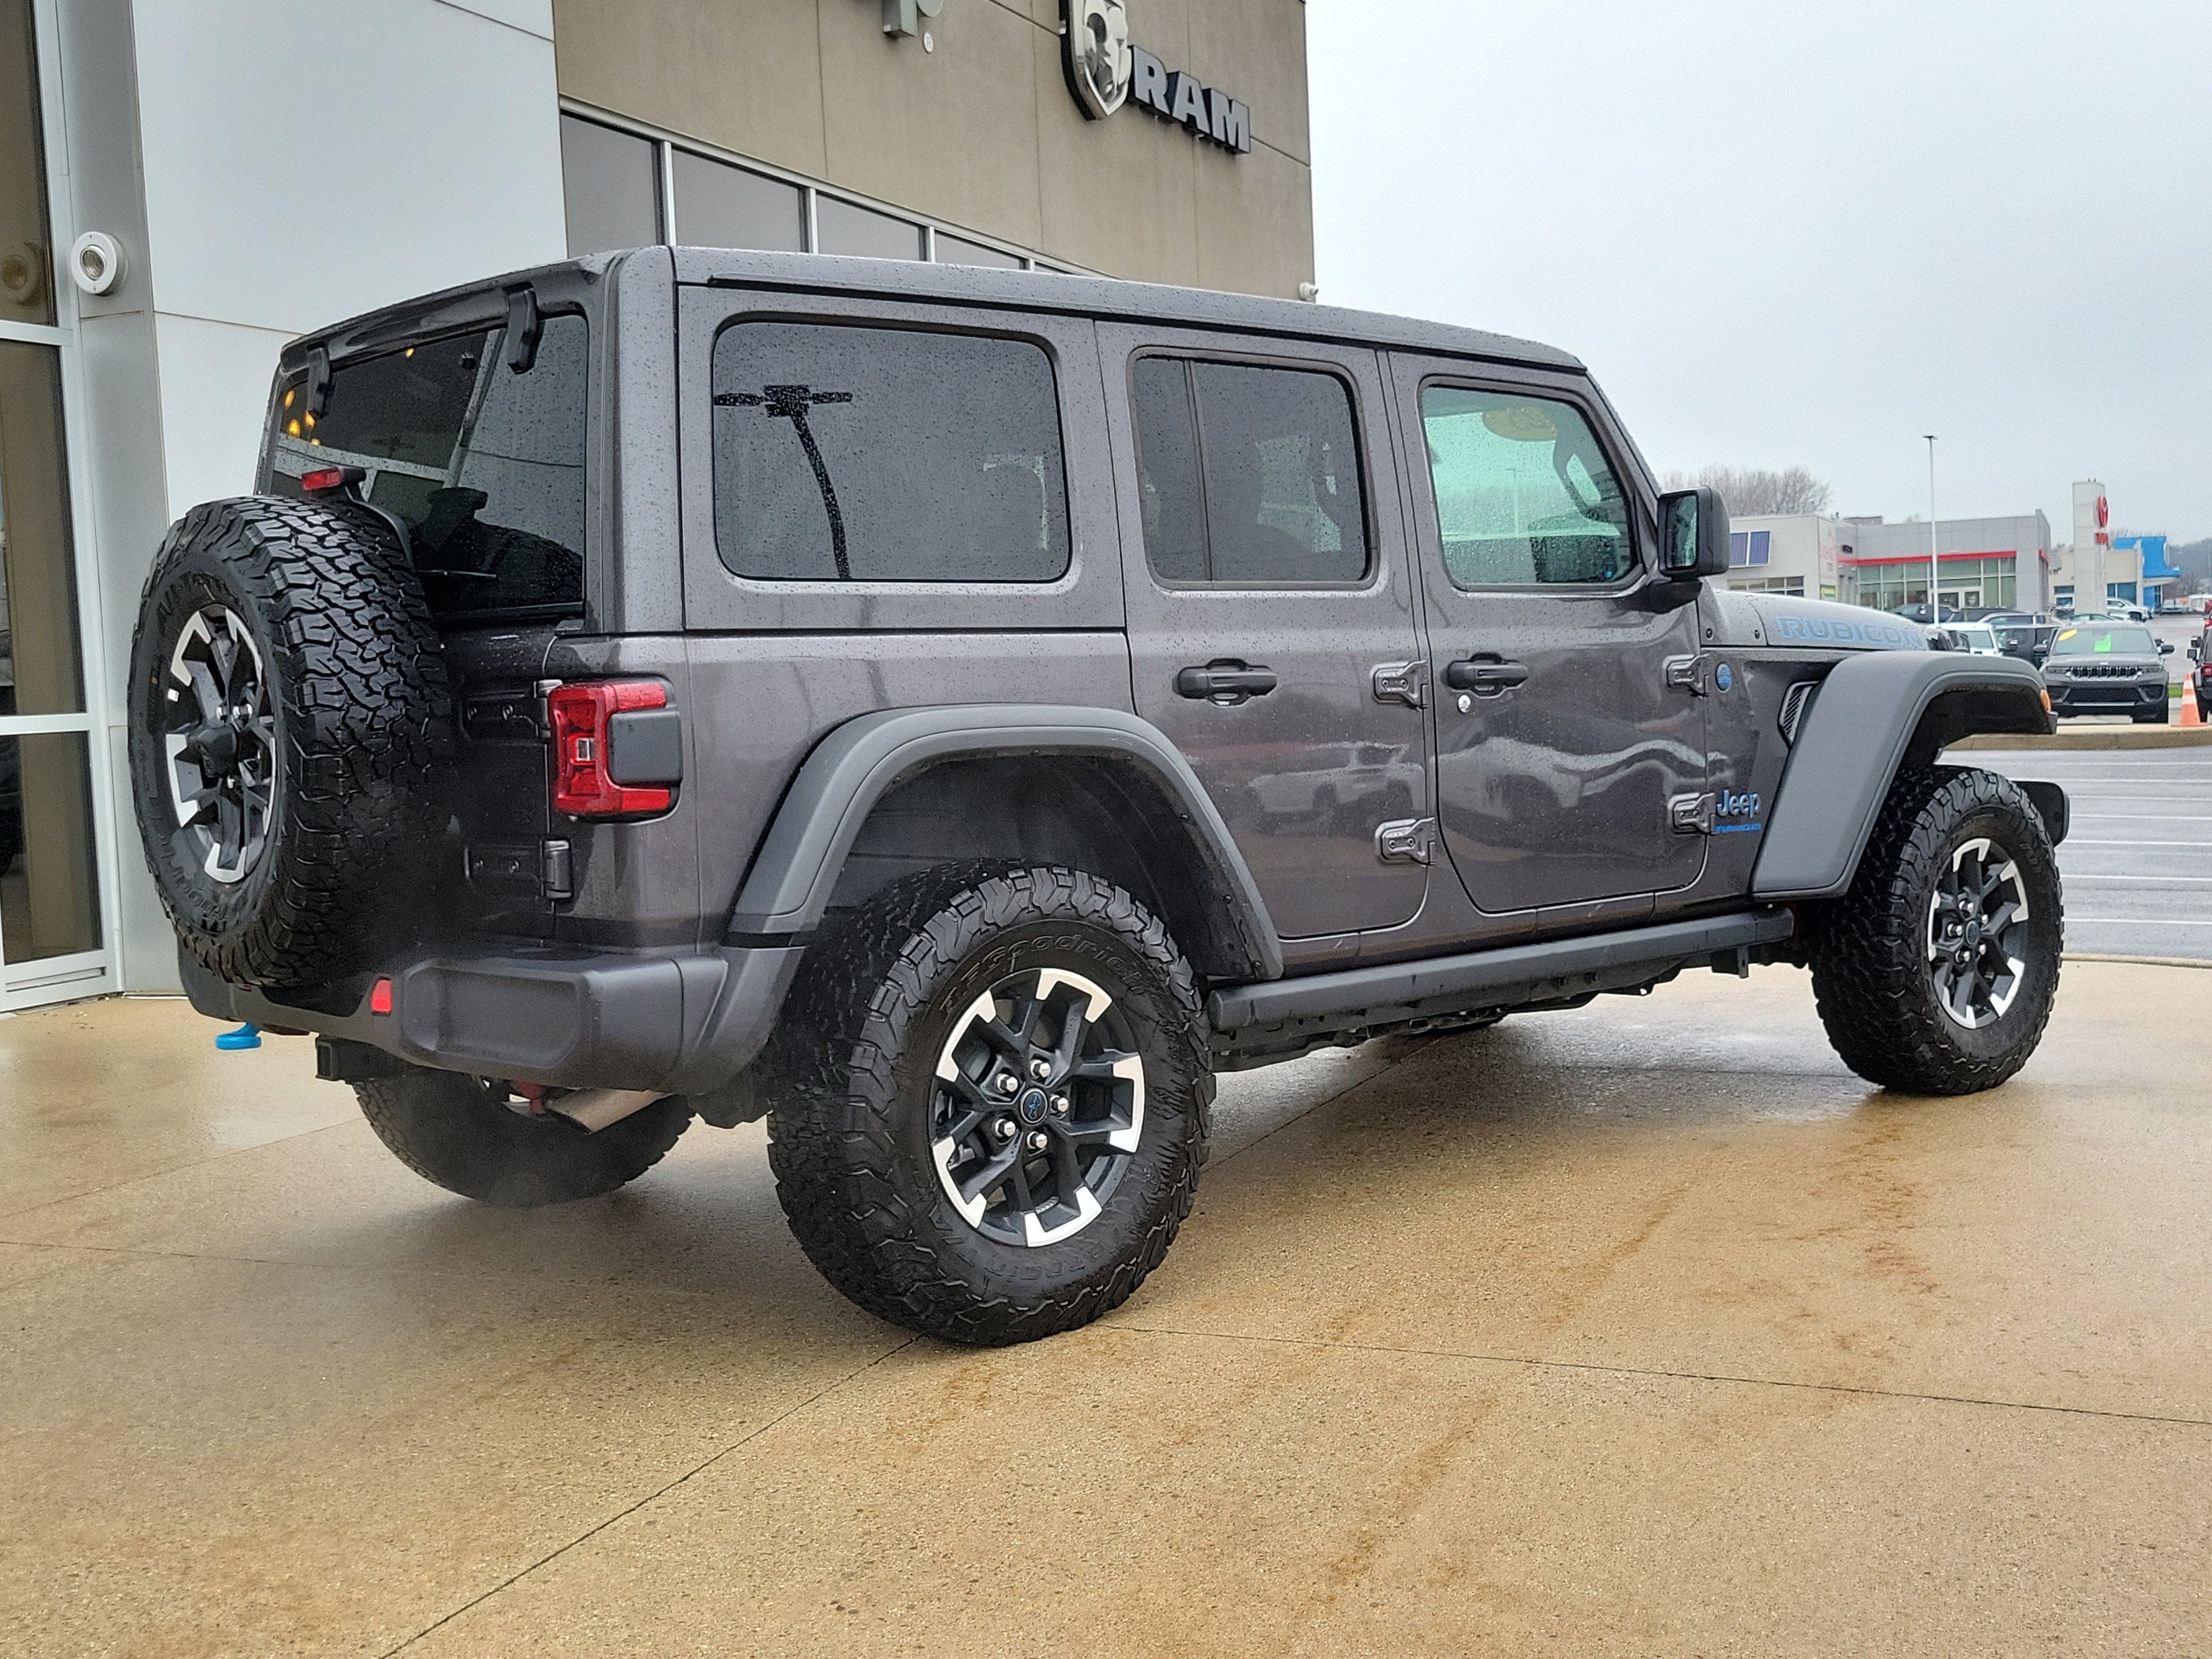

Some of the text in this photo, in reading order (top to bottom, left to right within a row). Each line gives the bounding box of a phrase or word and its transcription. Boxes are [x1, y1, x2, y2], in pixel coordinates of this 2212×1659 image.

[1133, 44, 1251, 154] RAM
[1778, 617, 1925, 648] RUBICON
[1716, 789, 1760, 819] Jeep
